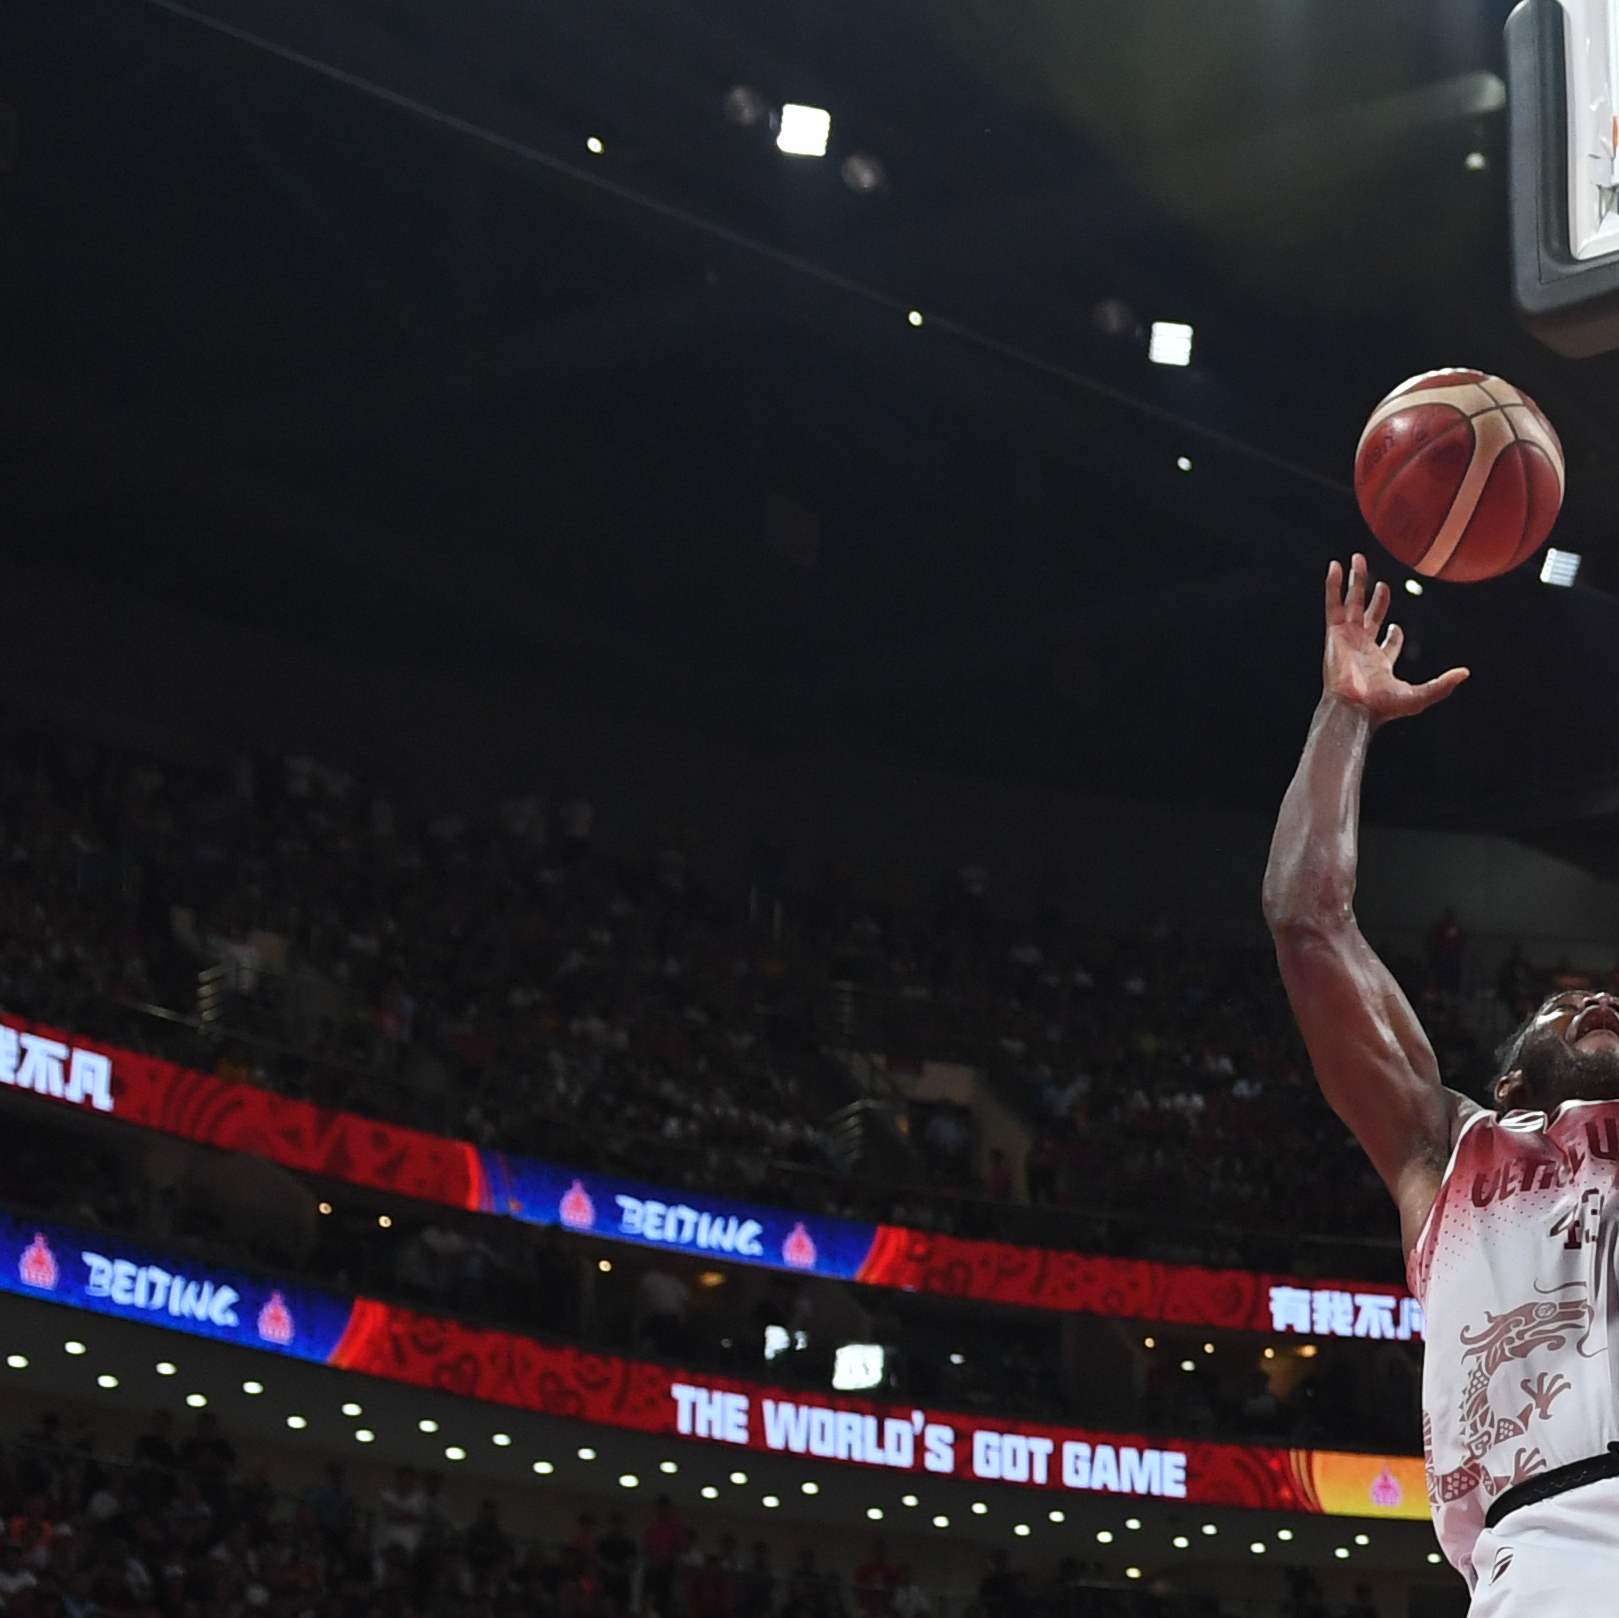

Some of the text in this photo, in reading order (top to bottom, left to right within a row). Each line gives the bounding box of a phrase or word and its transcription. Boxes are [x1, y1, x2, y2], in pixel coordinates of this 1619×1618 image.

[614, 1193, 764, 1257] BEIJING
[82, 1251, 242, 1329] BEIJING
[671, 1381, 1188, 1499] THE WORLD'S GOT GAME
